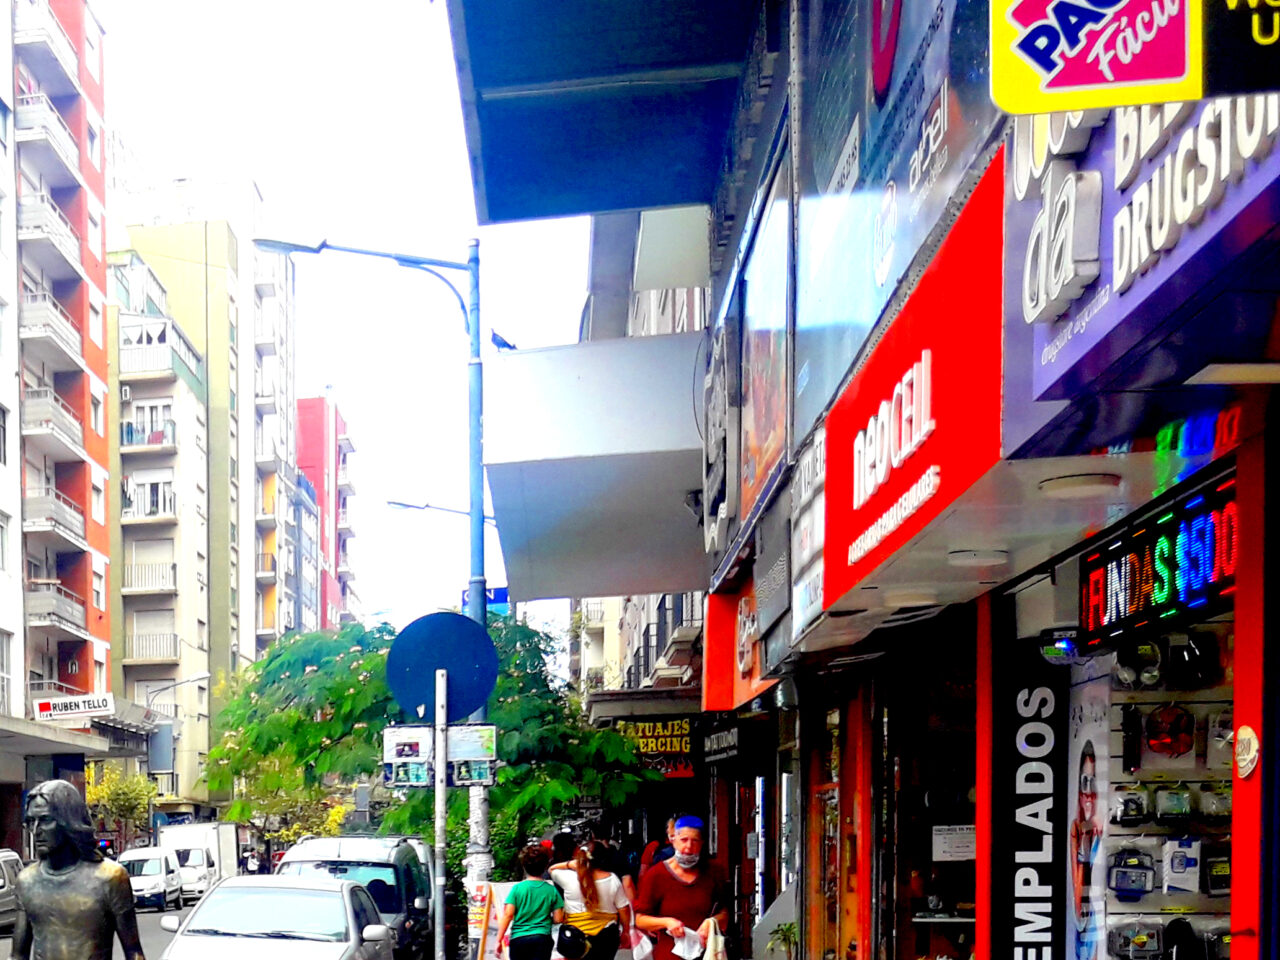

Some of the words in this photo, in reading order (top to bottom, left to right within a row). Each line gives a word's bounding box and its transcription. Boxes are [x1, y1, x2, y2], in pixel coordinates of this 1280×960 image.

[1087, 535, 1169, 632] FUNDAS
[52, 701, 80, 713] RUBEN
[82, 698, 108, 710] TELLO
[633, 736, 691, 753] ERCING
